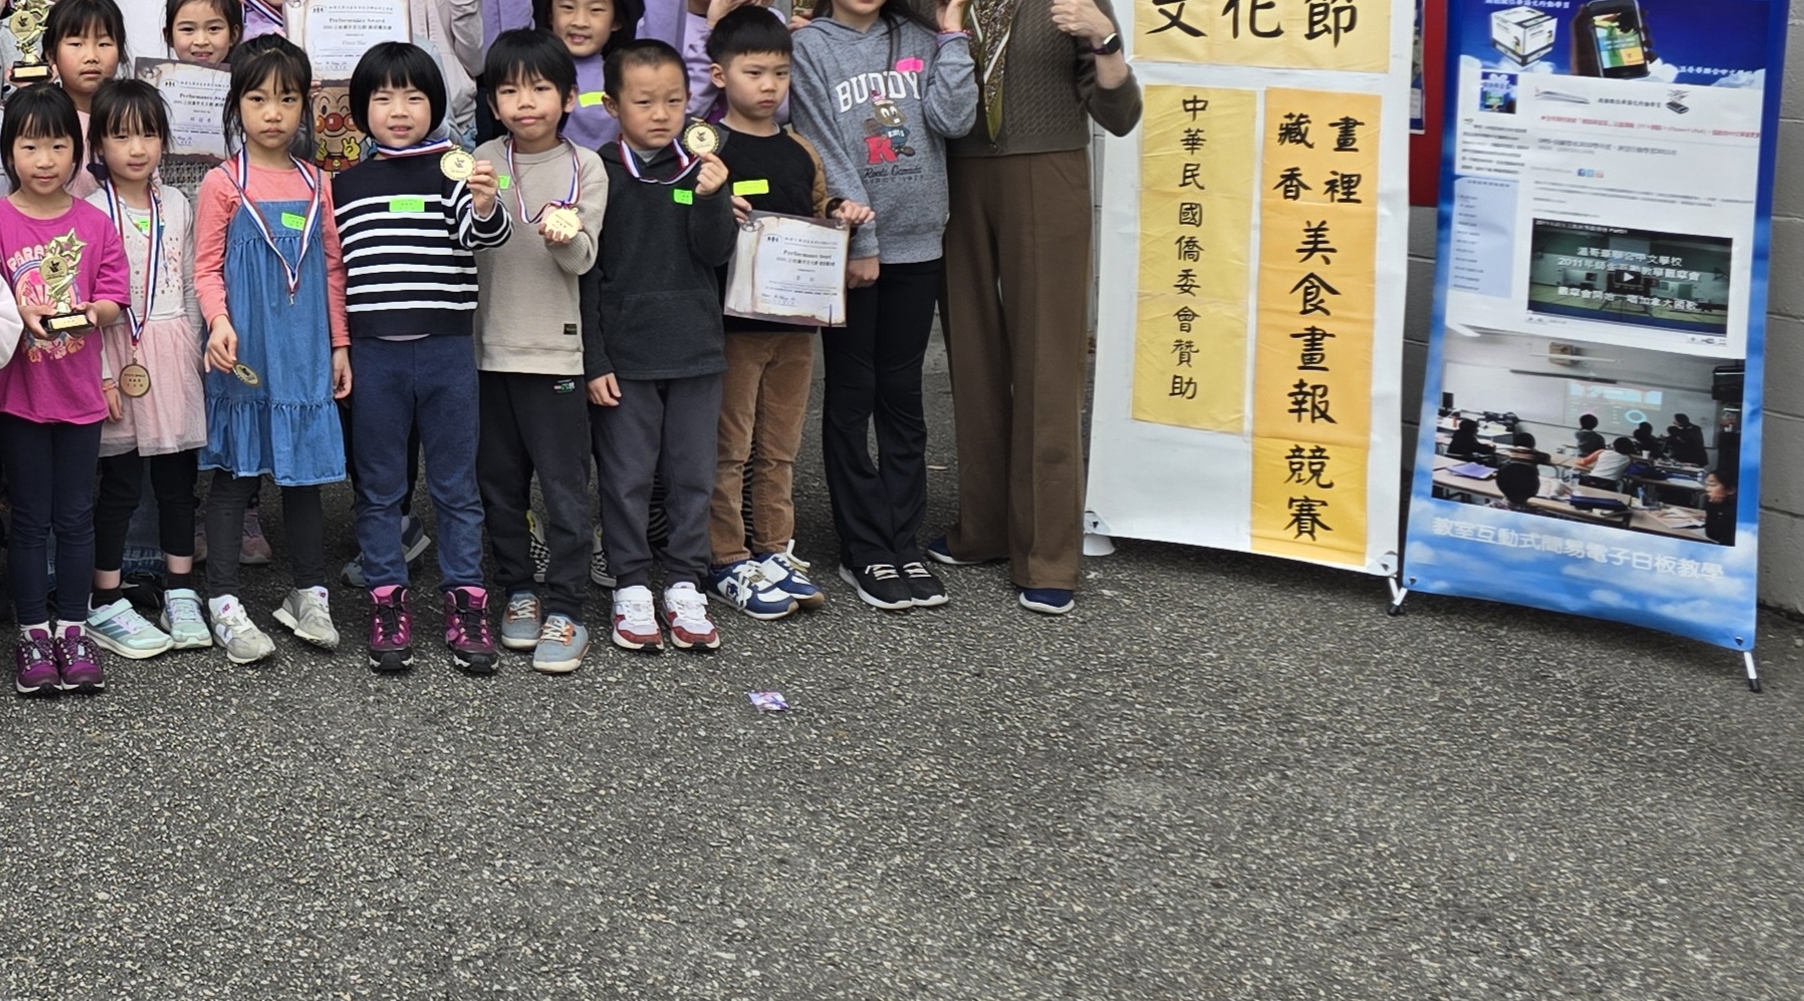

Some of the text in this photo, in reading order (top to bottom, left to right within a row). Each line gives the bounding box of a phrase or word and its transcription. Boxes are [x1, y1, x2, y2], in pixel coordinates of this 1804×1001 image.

[835, 70, 921, 113] BUDDY
[864, 135, 899, 165] R
[1272, 111, 1315, 202] 藏香
[1323, 115, 1366, 205] 畫裡
[6, 243, 48, 273] PARA
[1168, 94, 1209, 400] 中華民國僑委會贊助
[1283, 219, 1342, 542] 美食畫報競賽
